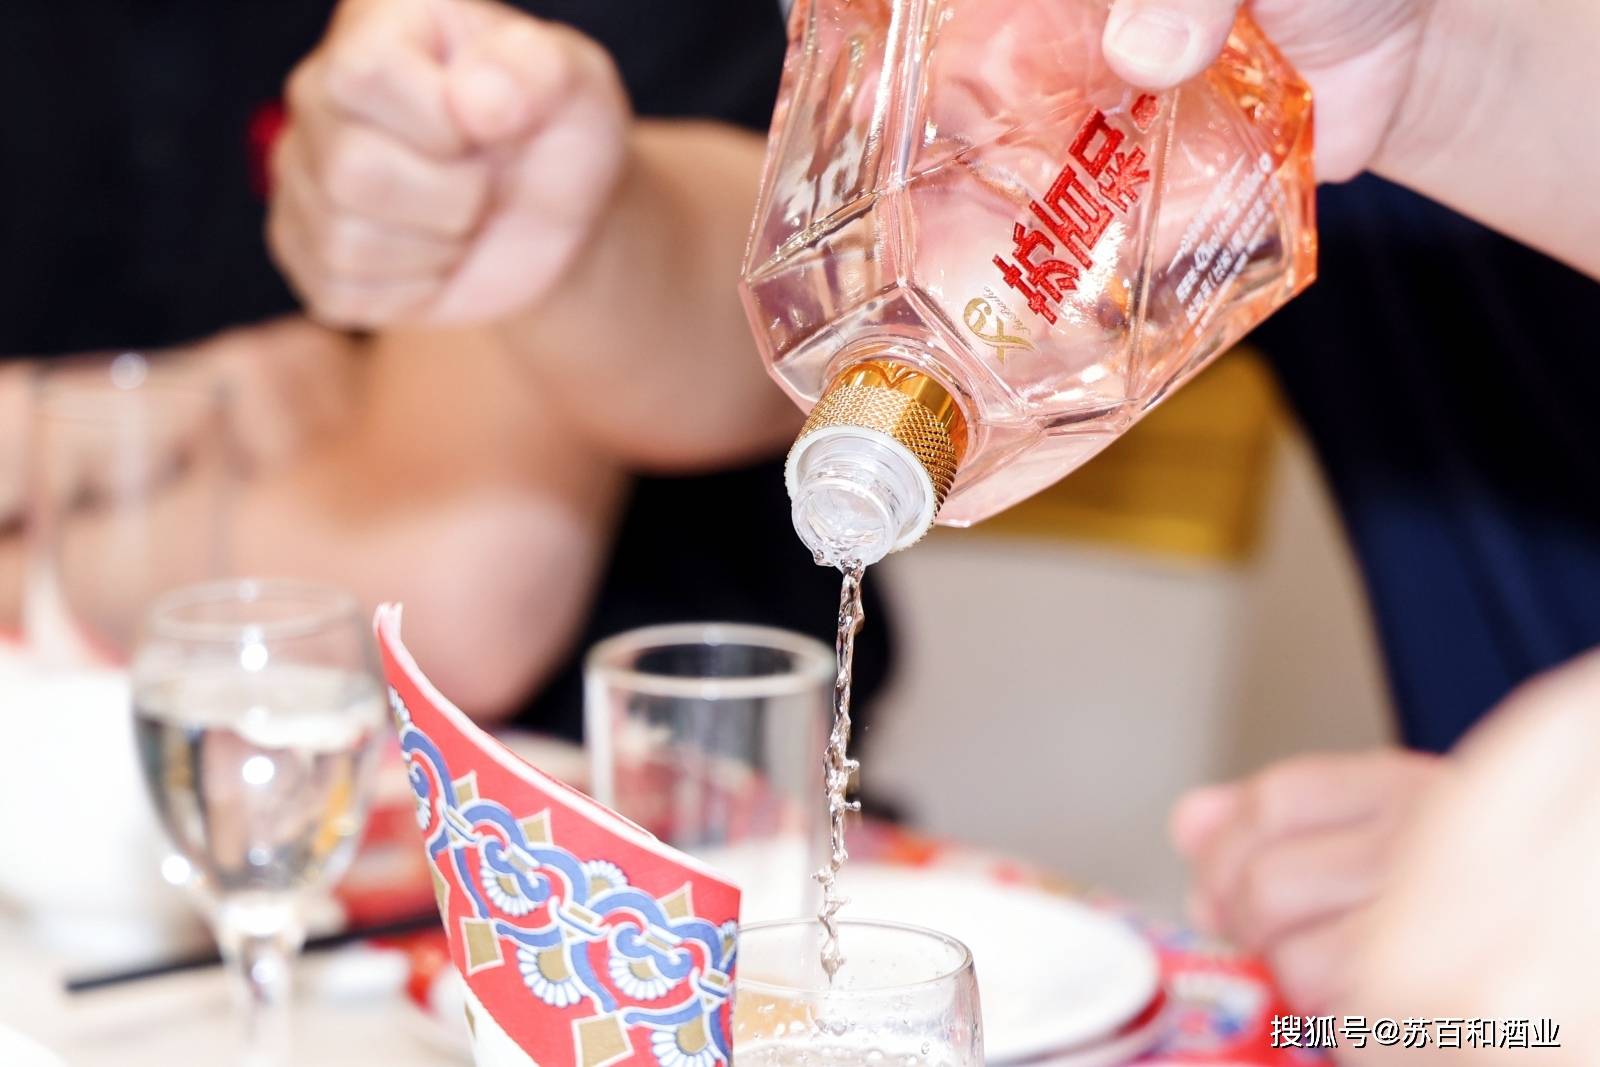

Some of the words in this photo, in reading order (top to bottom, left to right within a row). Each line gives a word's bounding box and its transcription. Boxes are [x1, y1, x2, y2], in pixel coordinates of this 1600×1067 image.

[993, 109, 1149, 325] 苏百和
[964, 297, 1035, 366] X9
